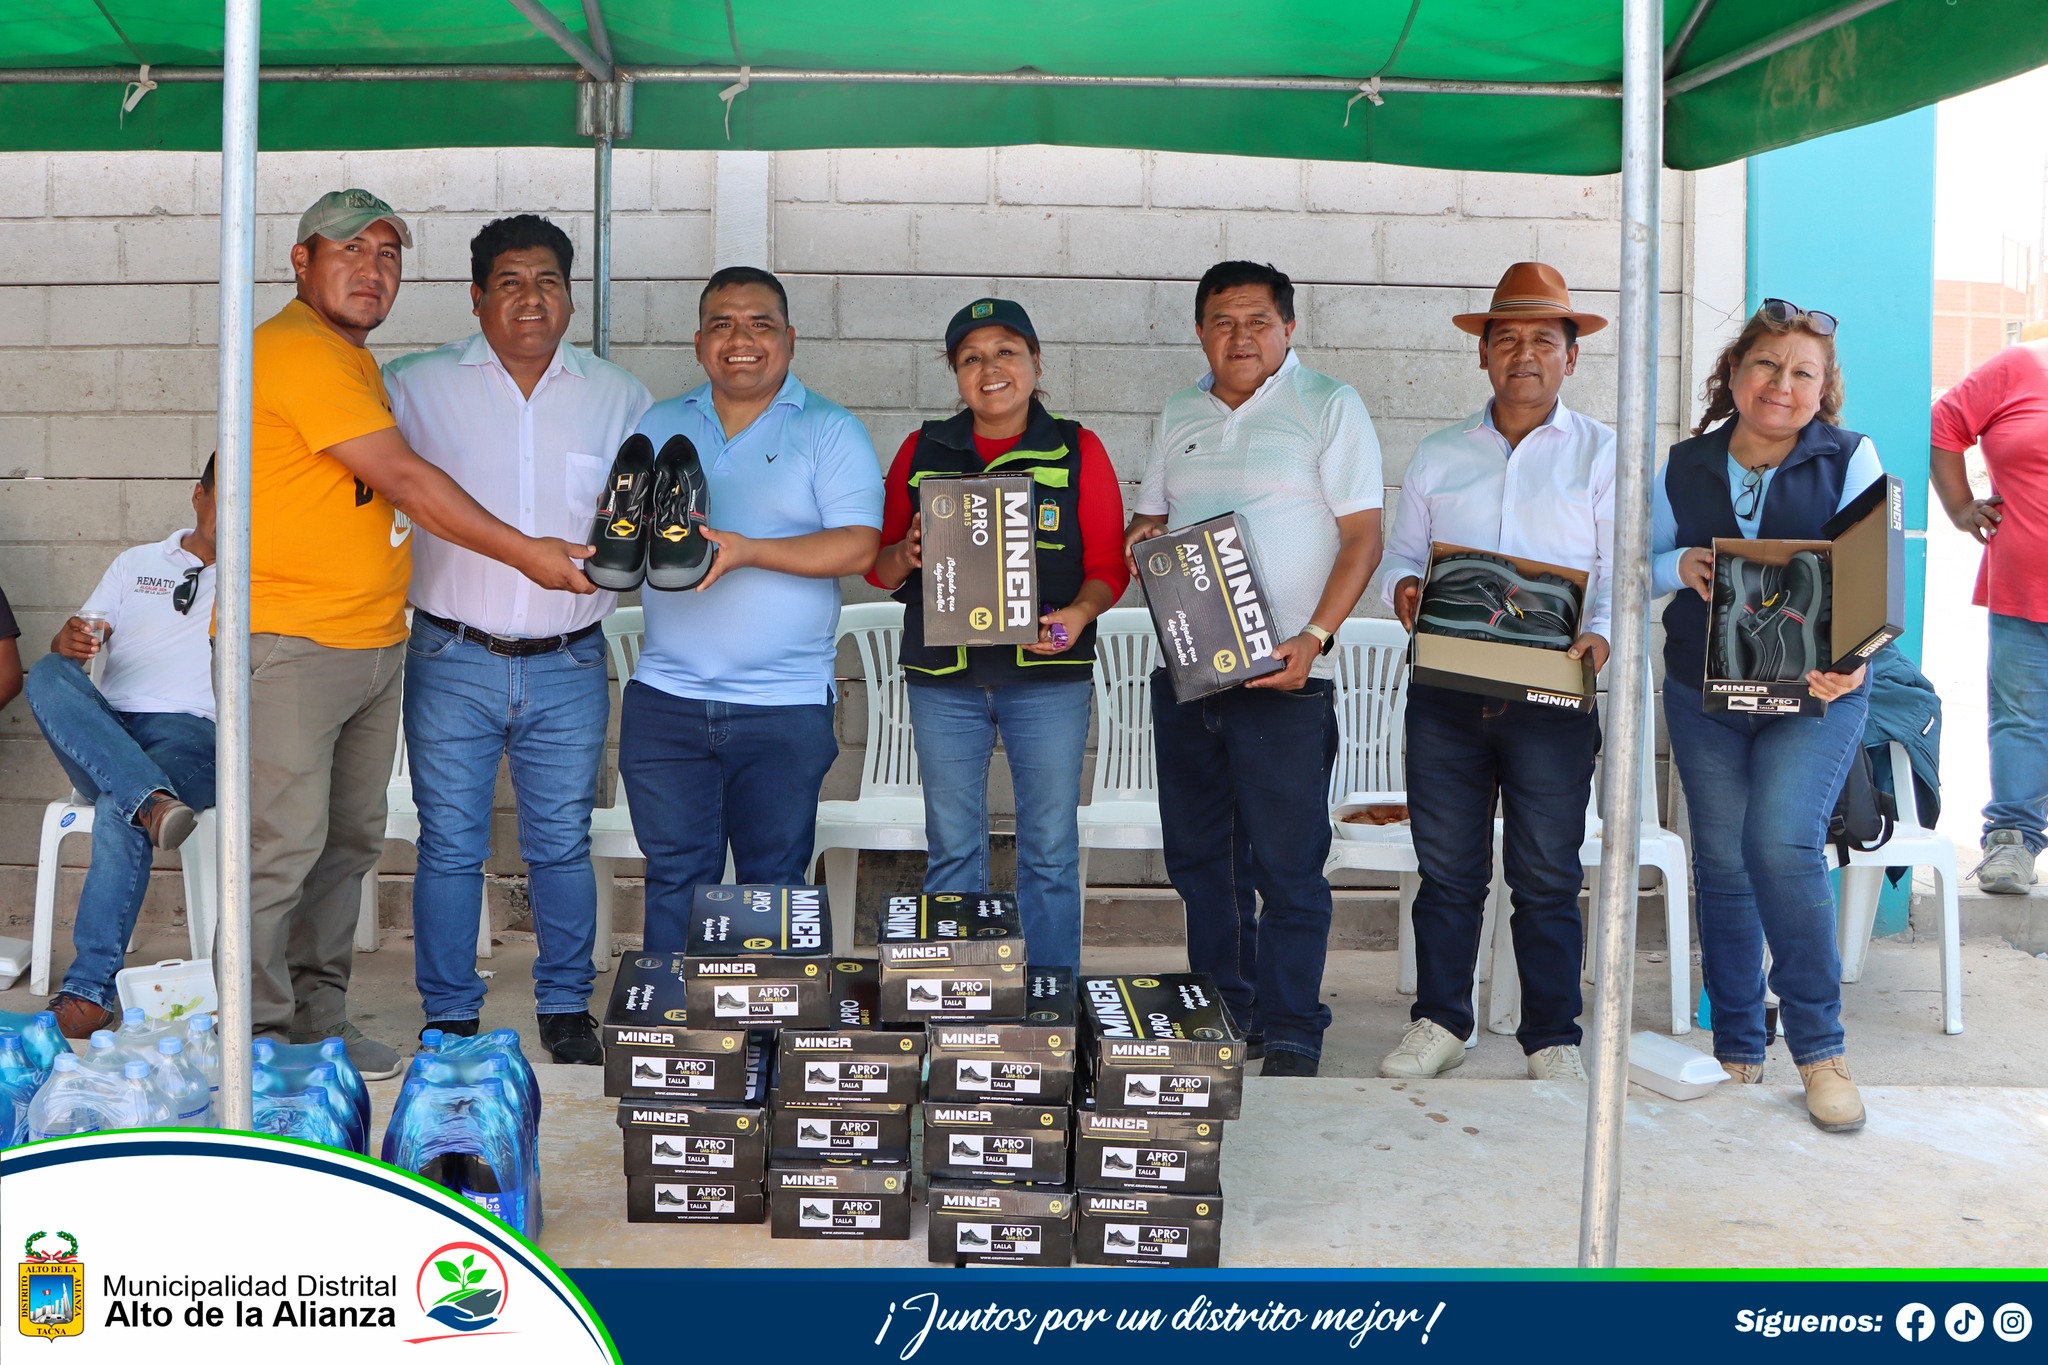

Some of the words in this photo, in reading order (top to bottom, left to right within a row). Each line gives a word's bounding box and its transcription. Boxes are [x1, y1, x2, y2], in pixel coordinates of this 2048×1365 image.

[963, 493, 971, 526] LMB-815
[1892, 486, 1901, 531] MINER
[971, 493, 988, 546] APRO
[1004, 492, 1031, 627] MINER
[1176, 545, 1190, 577] LMB-815
[933, 562, 944, 583] deja
[1183, 543, 1210, 591] APRO
[946, 556, 956, 595] ¡Calzado
[137, 577, 175, 588] RENATO
[936, 584, 946, 613] huella!
[1213, 526, 1273, 661] MINER
[947, 595, 956, 612] que
[1168, 618, 1178, 638] deja
[1174, 637, 1189, 666] huella!
[1176, 610, 1192, 647] ¡Calzado
[1189, 646, 1197, 663] que
[1859, 634, 1892, 658] MINER
[1527, 692, 1580, 708] MINER
[752, 891, 771, 912] APRO
[792, 890, 821, 948] MINER
[887, 896, 917, 938] MINER
[938, 920, 957, 937] APRO
[892, 947, 949, 958] MINER
[699, 964, 756, 973] MINER
[759, 988, 789, 998] APRO
[951, 982, 982, 992] APRO
[840, 1000, 860, 1025] APRO
[1086, 980, 1133, 1037] MINER
[1148, 1013, 1175, 1039] APRO
[618, 1032, 674, 1043] MINER
[795, 1038, 852, 1047] MINER
[942, 1033, 999, 1044] MINER
[1112, 1045, 1169, 1056] MINER
[676, 1061, 706, 1071] APRO
[849, 1065, 879, 1074] APRO
[1001, 1064, 1032, 1075] APRO
[1170, 1078, 1201, 1088] APRO
[633, 1111, 688, 1123] MINER
[935, 1110, 991, 1121] MINER
[840, 1123, 870, 1132] APRO
[1091, 1117, 1148, 1130] MINER
[695, 1140, 725, 1150] APRO
[993, 1139, 1024, 1149] APRO
[1147, 1152, 1178, 1162] APRO
[782, 1175, 837, 1186] MINER
[697, 1188, 726, 1196] APRO
[842, 1202, 872, 1210] APRO
[944, 1195, 1000, 1207] MINER
[1090, 1198, 1147, 1210] MINER
[1001, 1227, 1032, 1237] APRO
[1149, 1229, 1180, 1239] APRO
